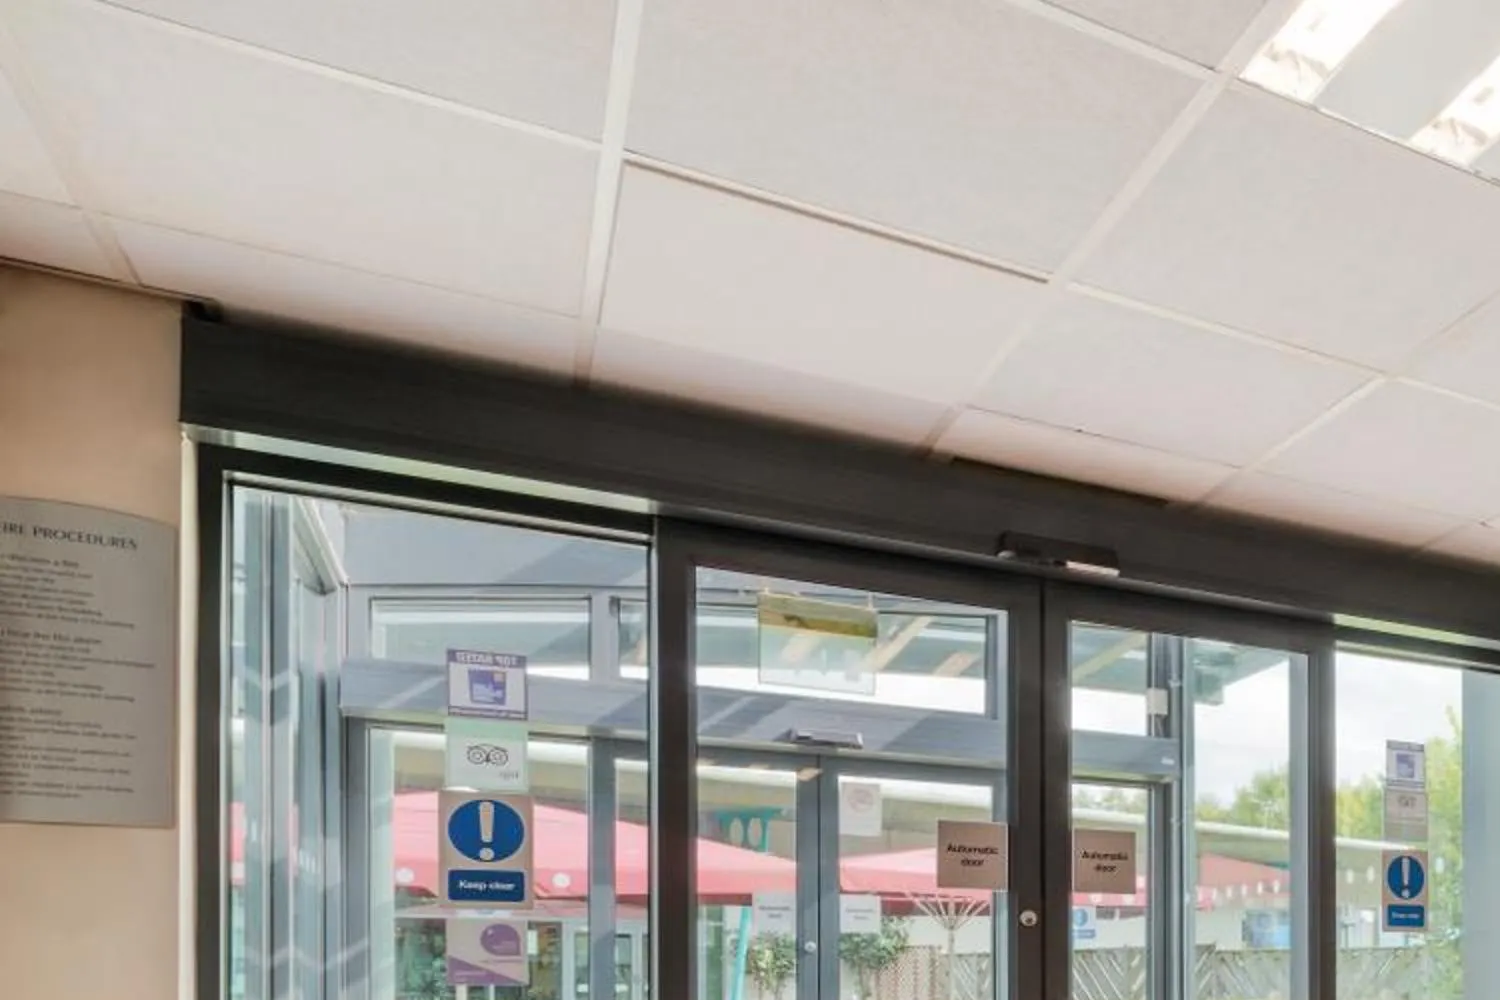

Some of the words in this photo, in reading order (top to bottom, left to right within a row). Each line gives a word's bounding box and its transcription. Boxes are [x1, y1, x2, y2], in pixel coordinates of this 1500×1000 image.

[0, 522, 24, 536] IRE
[32, 525, 137, 550] PROCEDURES
[946, 841, 999, 855] Automatic
[960, 857, 985, 867] door
[459, 879, 487, 893] Keep
[489, 881, 516, 892] clear
